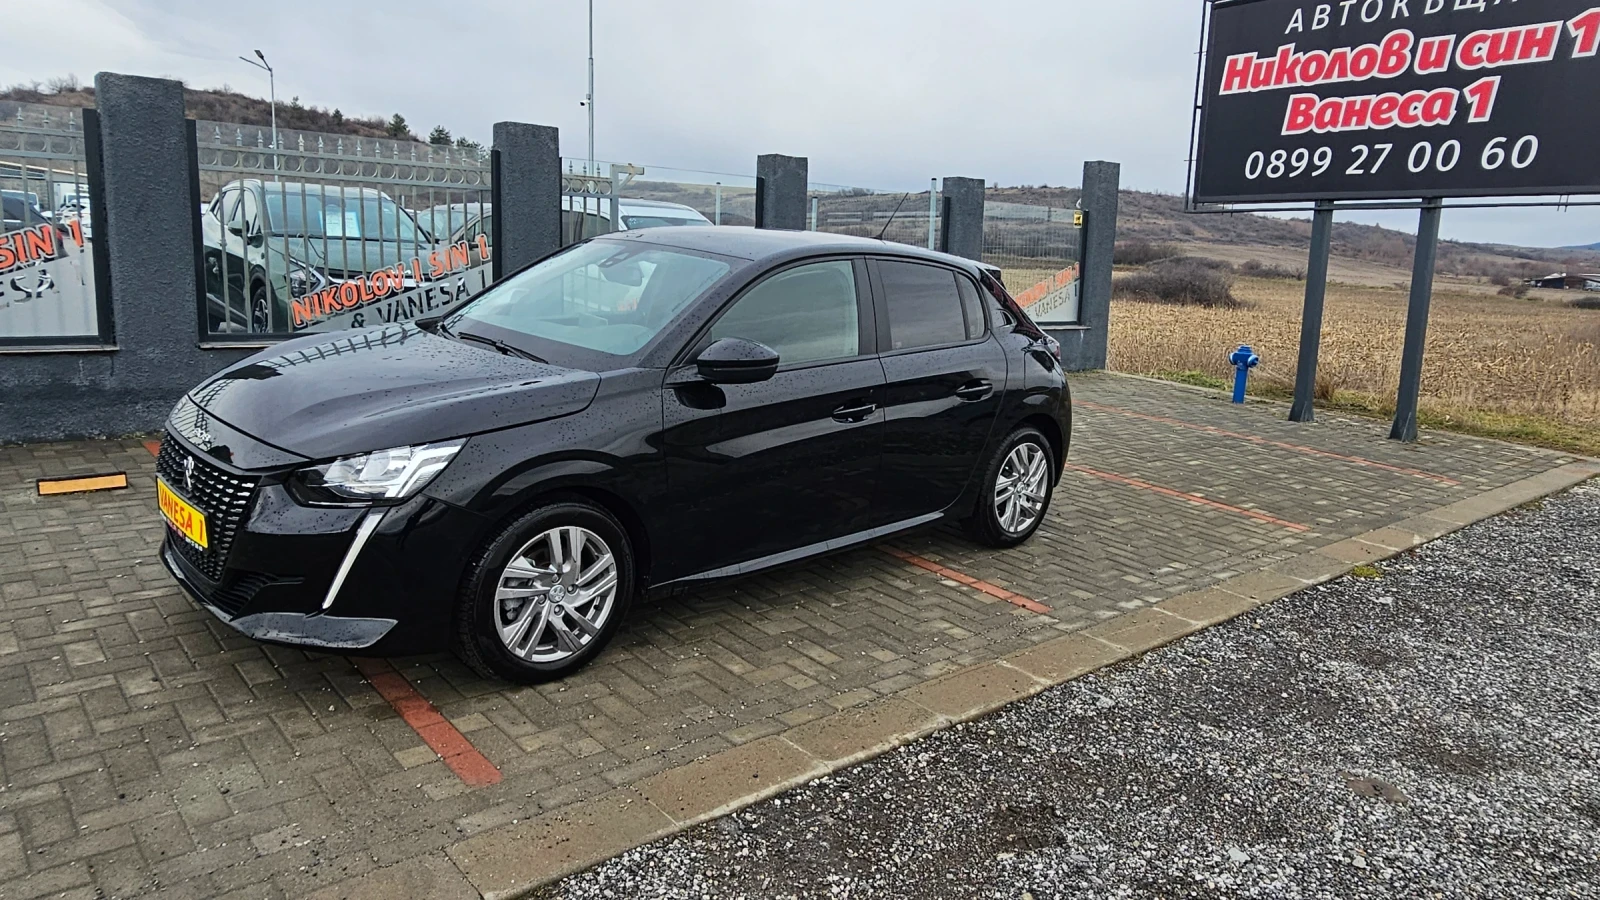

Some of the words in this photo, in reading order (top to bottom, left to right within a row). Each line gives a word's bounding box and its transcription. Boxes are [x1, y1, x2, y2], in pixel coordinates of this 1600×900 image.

[1284, 0, 1518, 34] АВТОКЪ
[1219, 29, 1414, 95] Николов
[1414, 35, 1456, 75] и
[1455, 20, 1564, 70] син
[1566, 7, 1600, 58] 1
[1281, 87, 1460, 135] Ванеса
[1463, 75, 1501, 123] 1
[1245, 146, 1332, 179] 0899
[1345, 143, 1393, 175] 27
[1407, 139, 1461, 173] 00
[1481, 135, 1539, 170] 60
[68, 219, 84, 248] 1
[291, 262, 405, 326] NIKOLOV
[412, 257, 423, 283] I
[429, 240, 471, 279] SIN
[477, 234, 489, 260] 1
[351, 312, 366, 328] &
[375, 277, 471, 323] VANESA
[159, 484, 194, 536] VANESA
[199, 518, 204, 542] 1
